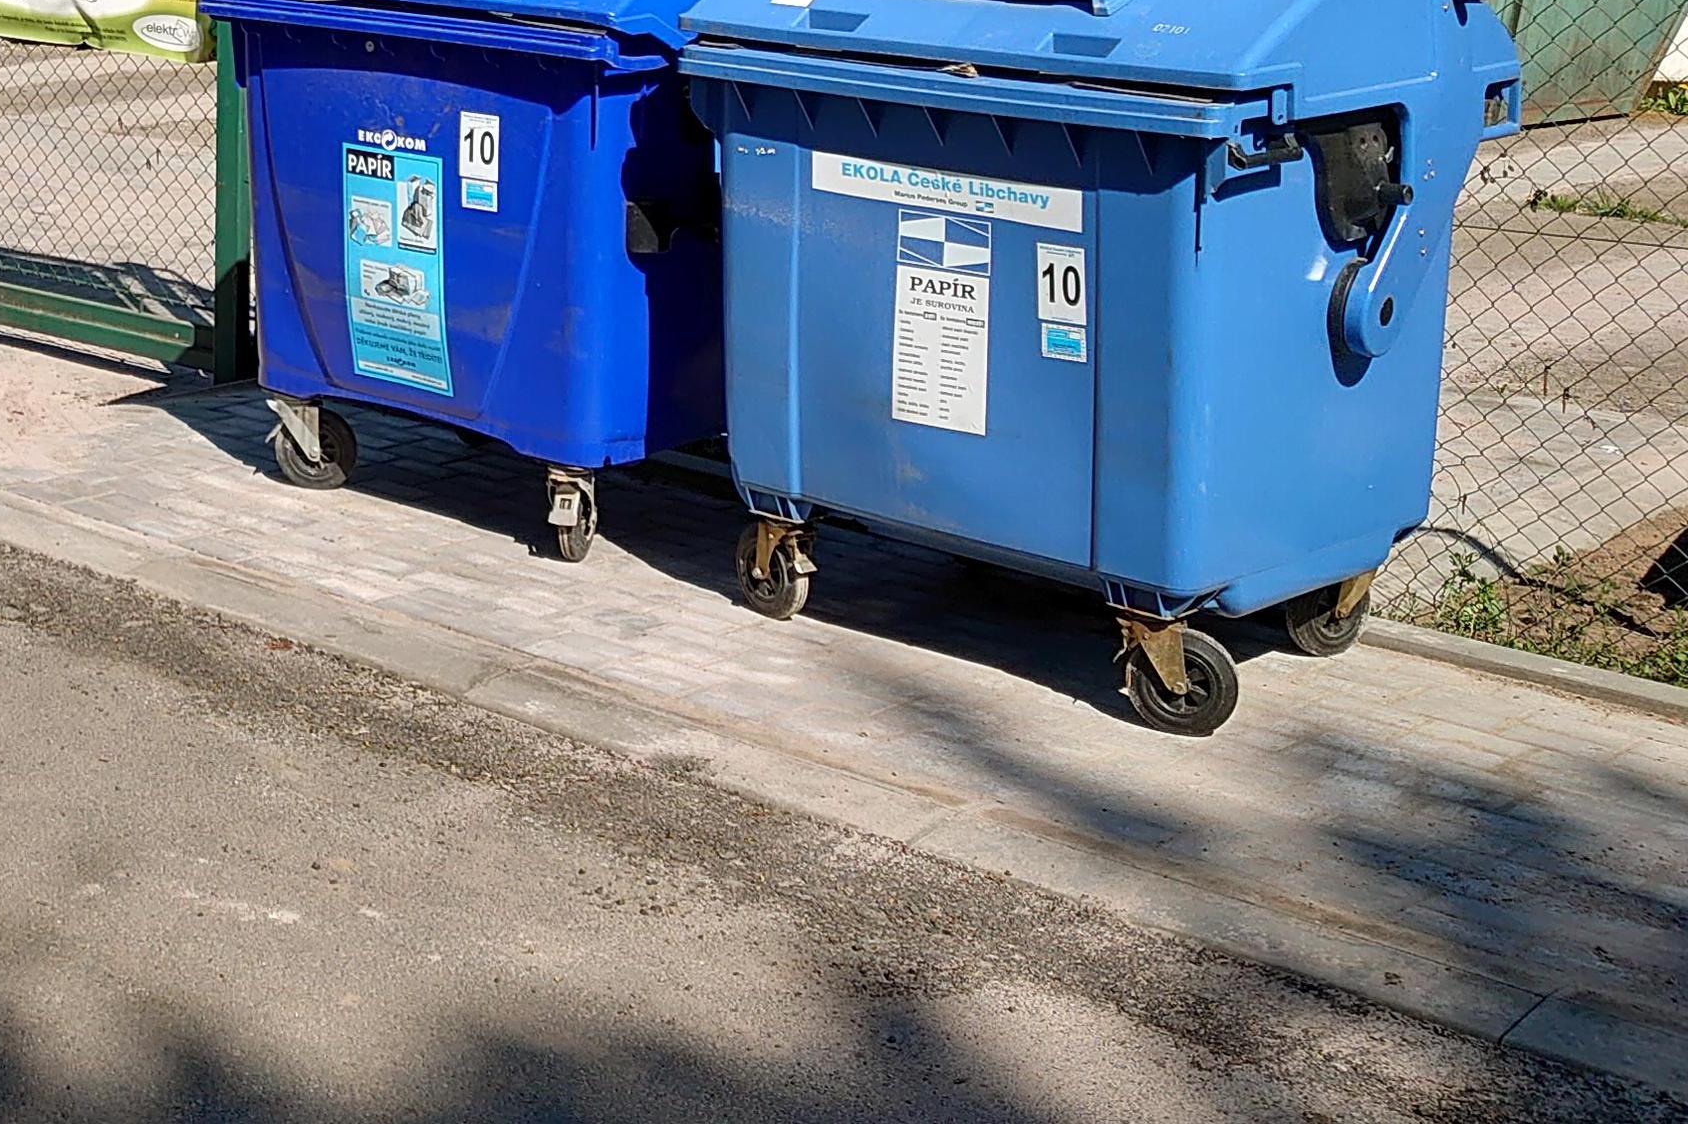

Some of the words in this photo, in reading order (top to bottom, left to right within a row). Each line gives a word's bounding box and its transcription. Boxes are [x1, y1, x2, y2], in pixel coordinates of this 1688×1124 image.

[463, 127, 495, 165] 10
[347, 153, 393, 180] PAPÍR
[841, 162, 902, 185] EKOLA
[907, 168, 962, 194] České
[969, 180, 1050, 209] Libchavy
[894, 190, 916, 200] Marius
[909, 276, 976, 301] PAPÍR
[1042, 262, 1081, 307] 10
[910, 297, 924, 306] JE
[925, 300, 975, 314] SUROVINA
